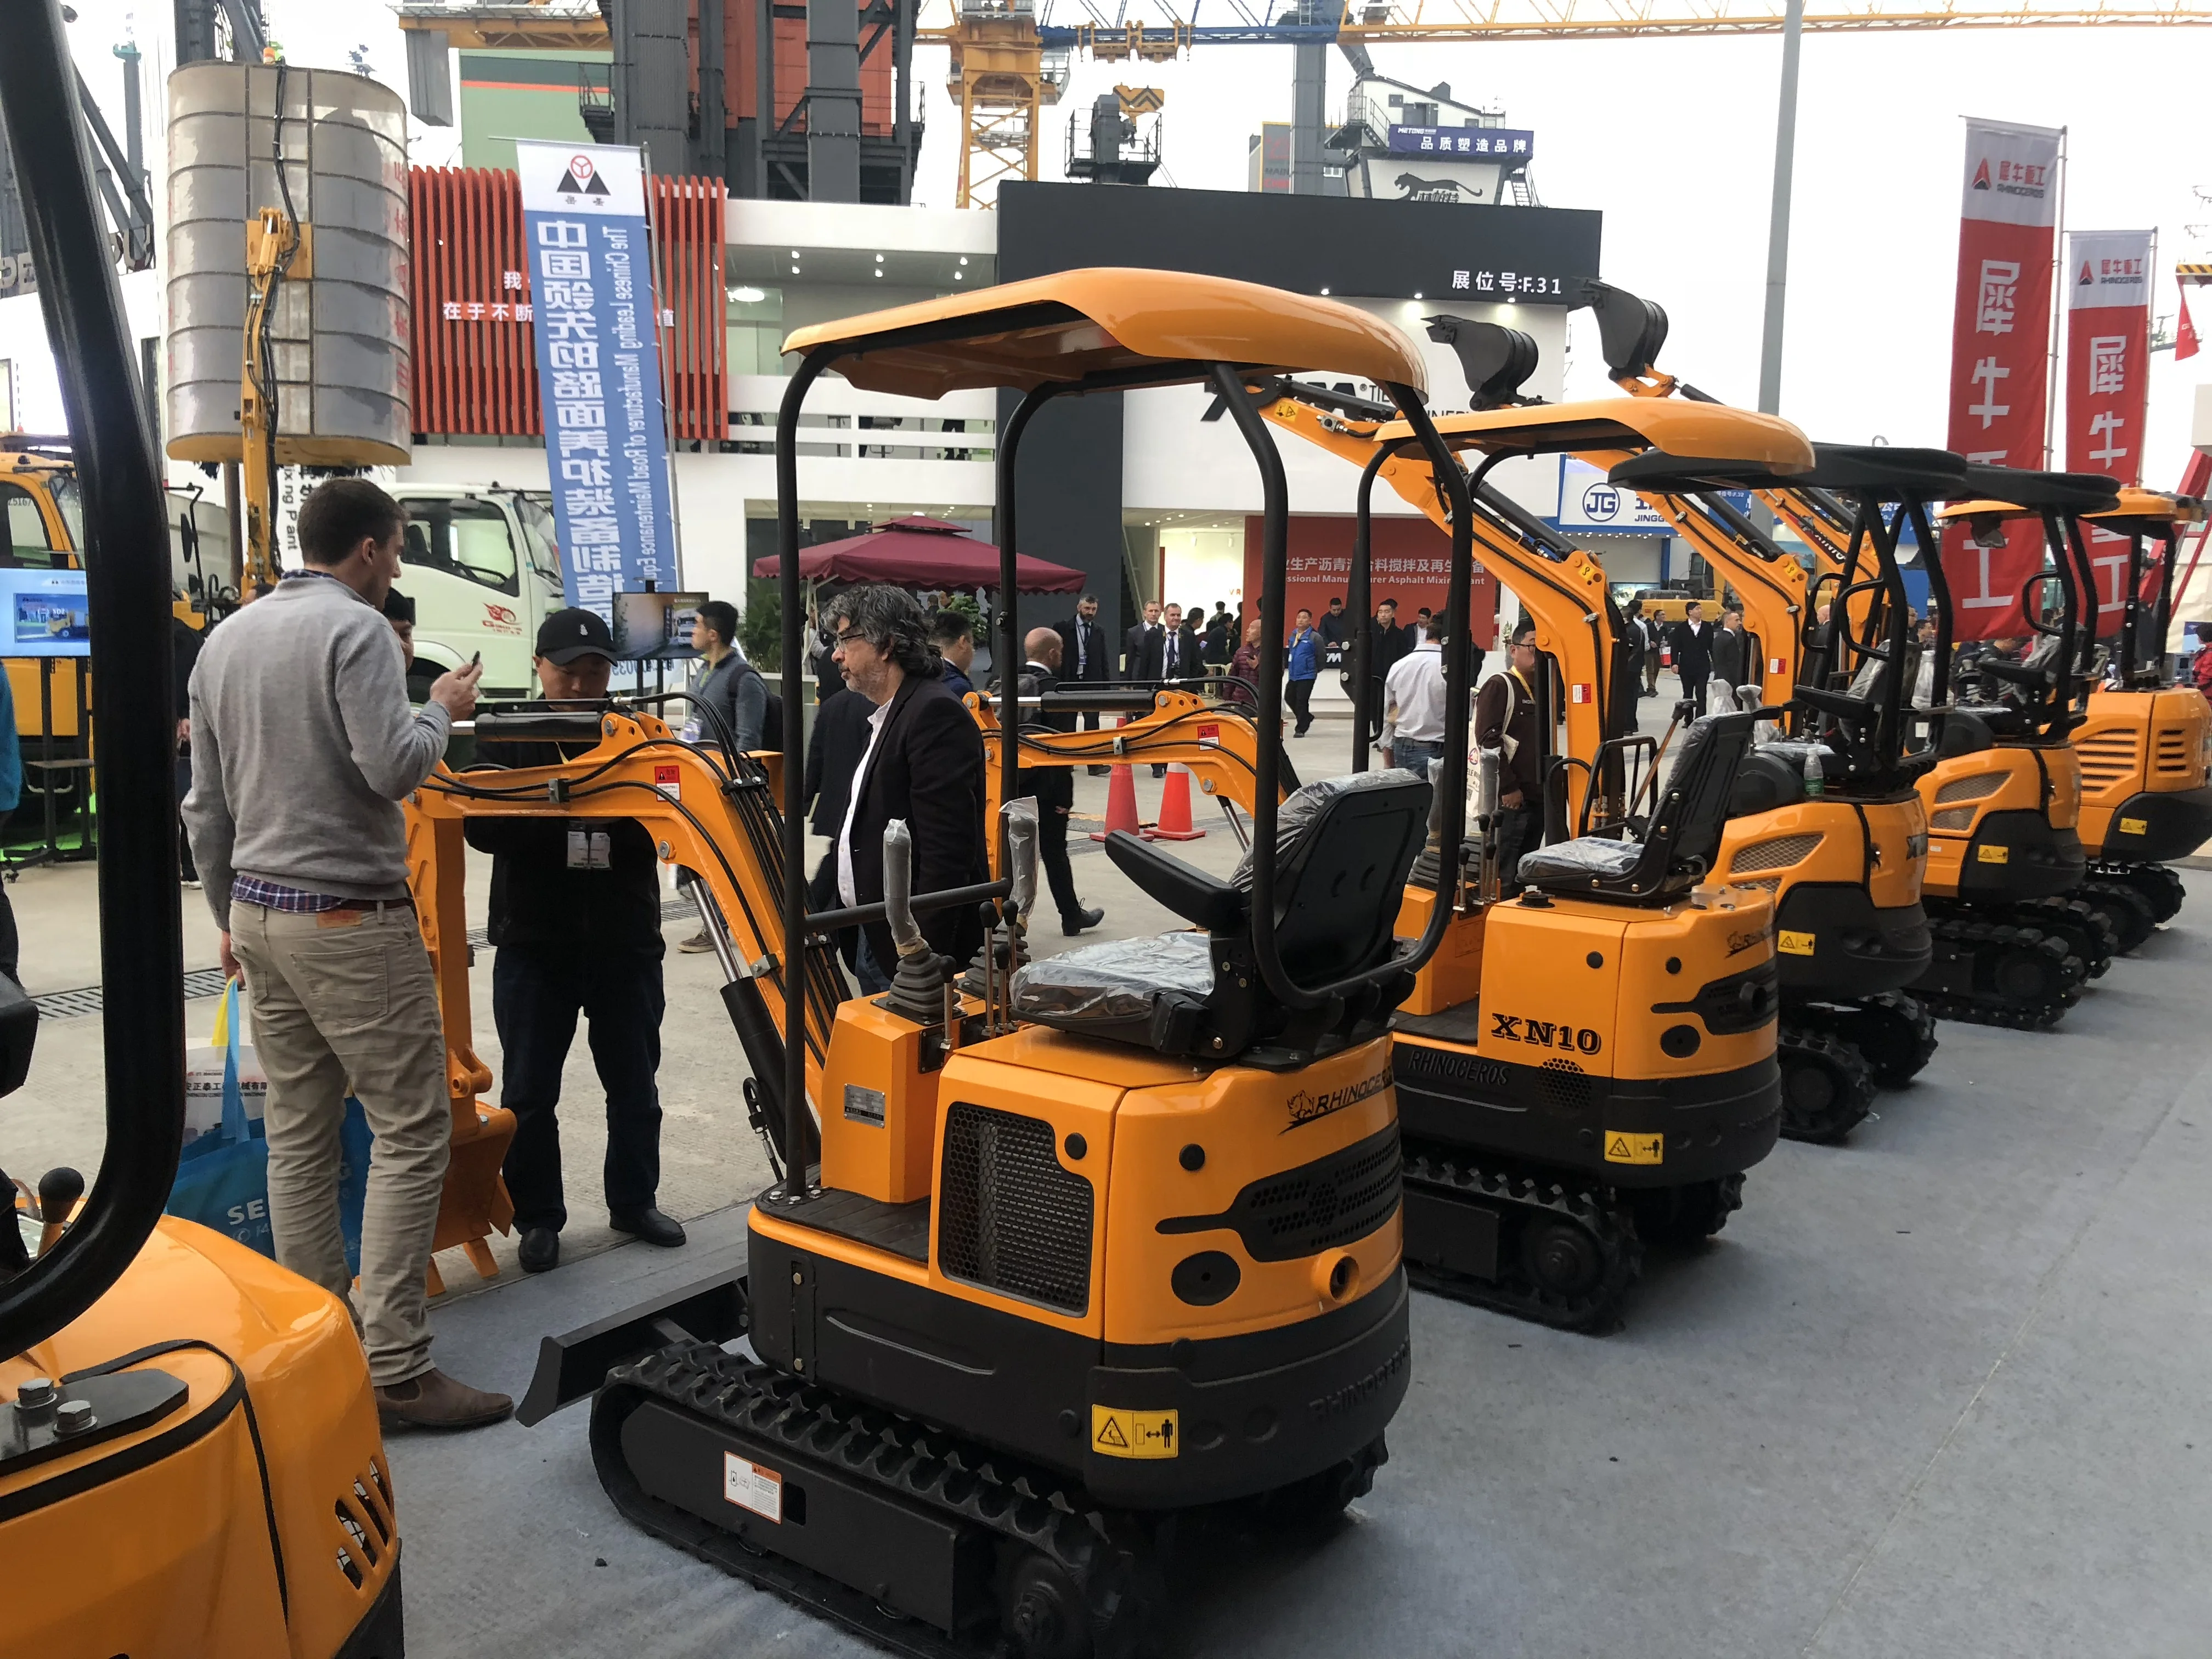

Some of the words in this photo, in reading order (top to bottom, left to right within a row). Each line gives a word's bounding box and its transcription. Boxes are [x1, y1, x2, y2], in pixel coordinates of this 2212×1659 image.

[1420, 136, 1527, 154] 品质塑造品牌
[1962, 259, 2021, 609] 犀牛工
[1586, 492, 1616, 513] JG
[1634, 514, 1668, 522] JINGG
[1388, 575, 1424, 585] Asphalt
[1489, 1012, 1601, 1056] XN10
[1408, 1049, 1510, 1086] RHINOCEROS
